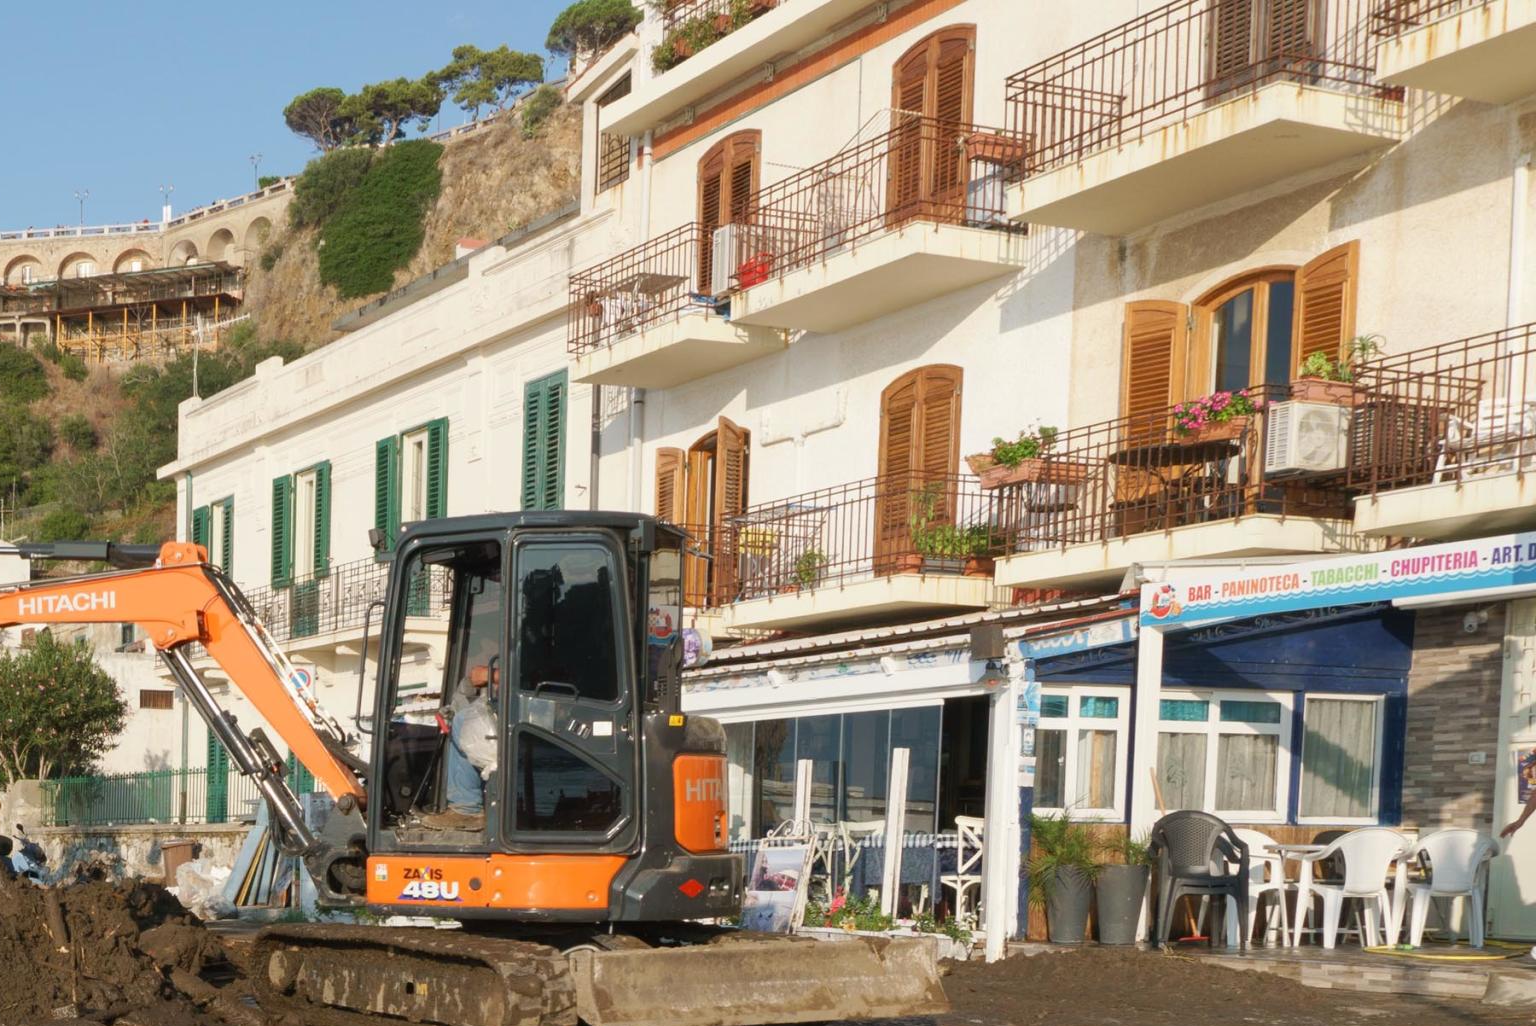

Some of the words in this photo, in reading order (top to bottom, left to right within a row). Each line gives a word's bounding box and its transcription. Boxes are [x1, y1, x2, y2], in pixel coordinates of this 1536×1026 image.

[1188, 585, 1212, 602] BAR
[1222, 573, 1299, 598] PANINOTECA
[1311, 563, 1379, 587] TABACCHI
[1390, 550, 1478, 577] CHUPITERIA
[1491, 544, 1524, 565] ART.
[18, 591, 116, 616] HITACHI
[403, 865, 443, 881] ZAXIS
[402, 880, 460, 900] 48U
